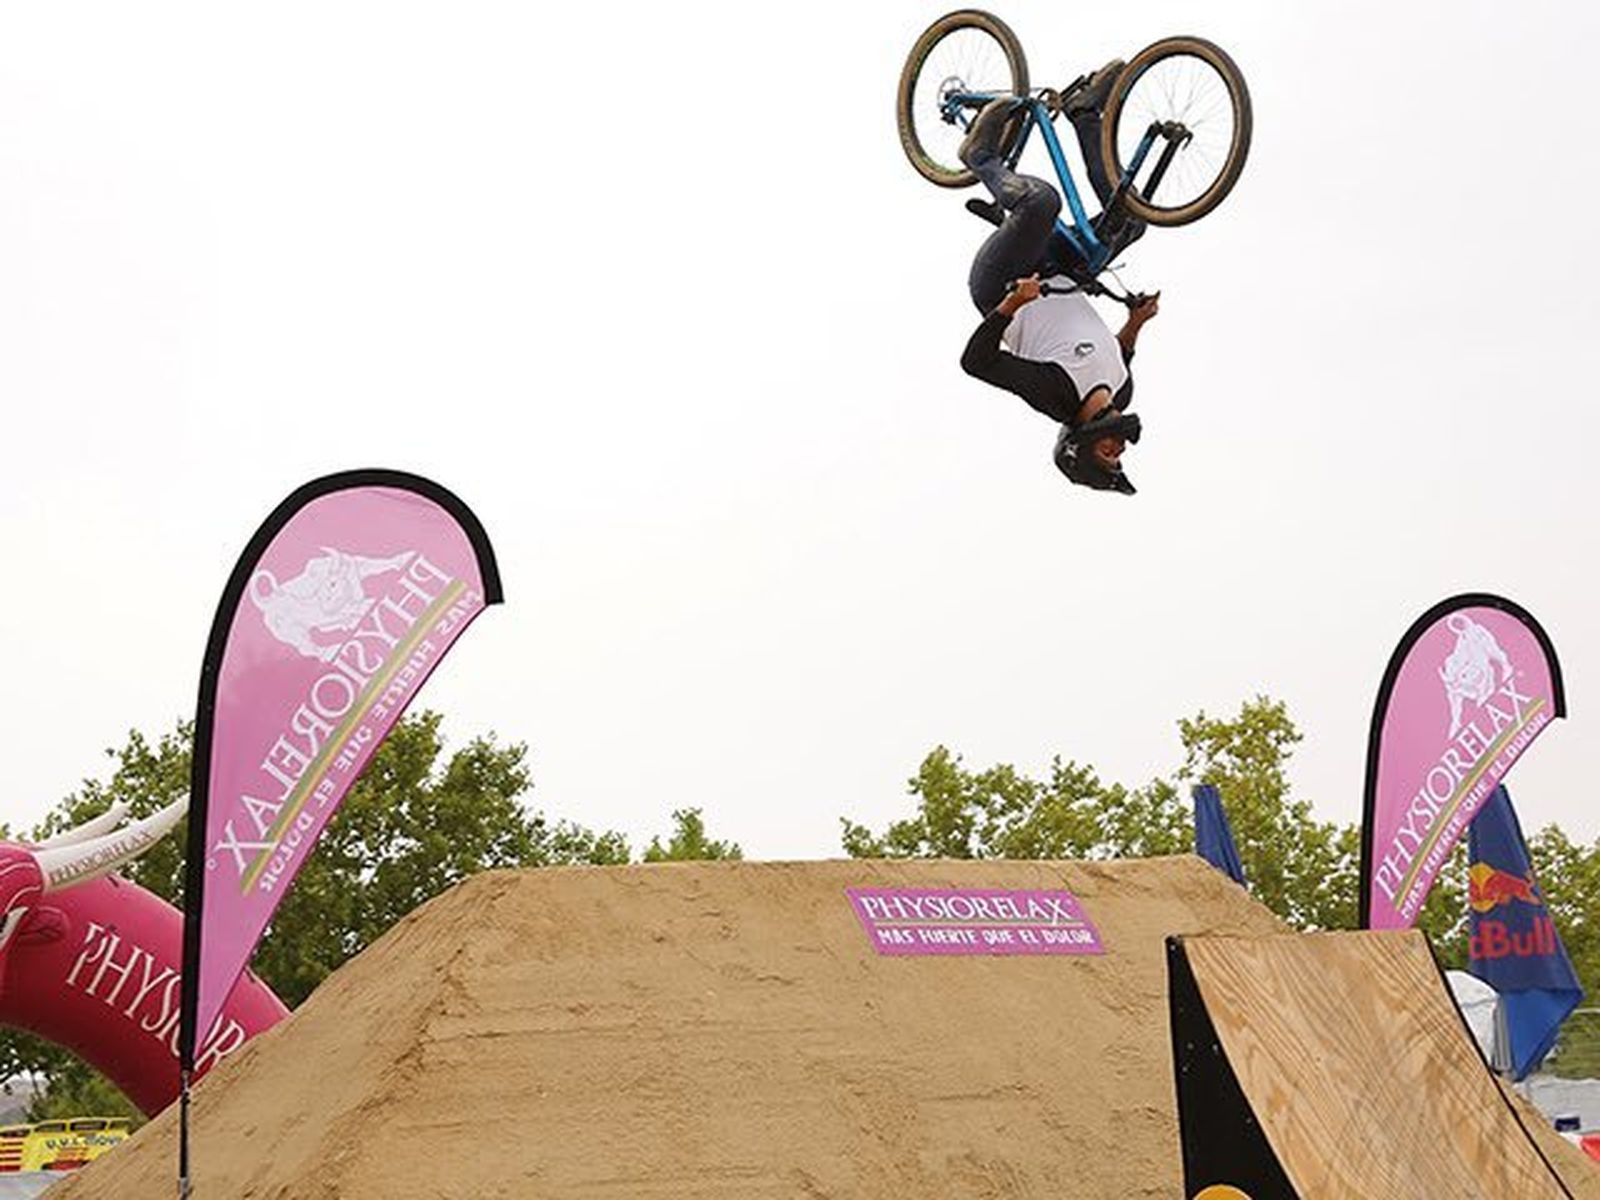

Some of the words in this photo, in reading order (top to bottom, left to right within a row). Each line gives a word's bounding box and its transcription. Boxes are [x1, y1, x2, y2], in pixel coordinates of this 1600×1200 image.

[1375, 676, 1533, 901] PHYSIORELAX
[1424, 815, 1462, 873] FUERTE
[1462, 782, 1488, 811] QUE
[860, 896, 1072, 926] PHYSIORELAX
[918, 929, 979, 944] FUERTE
[982, 929, 1014, 945] QUE
[1018, 929, 1040, 944] EL
[1041, 929, 1095, 944] DOLOR
